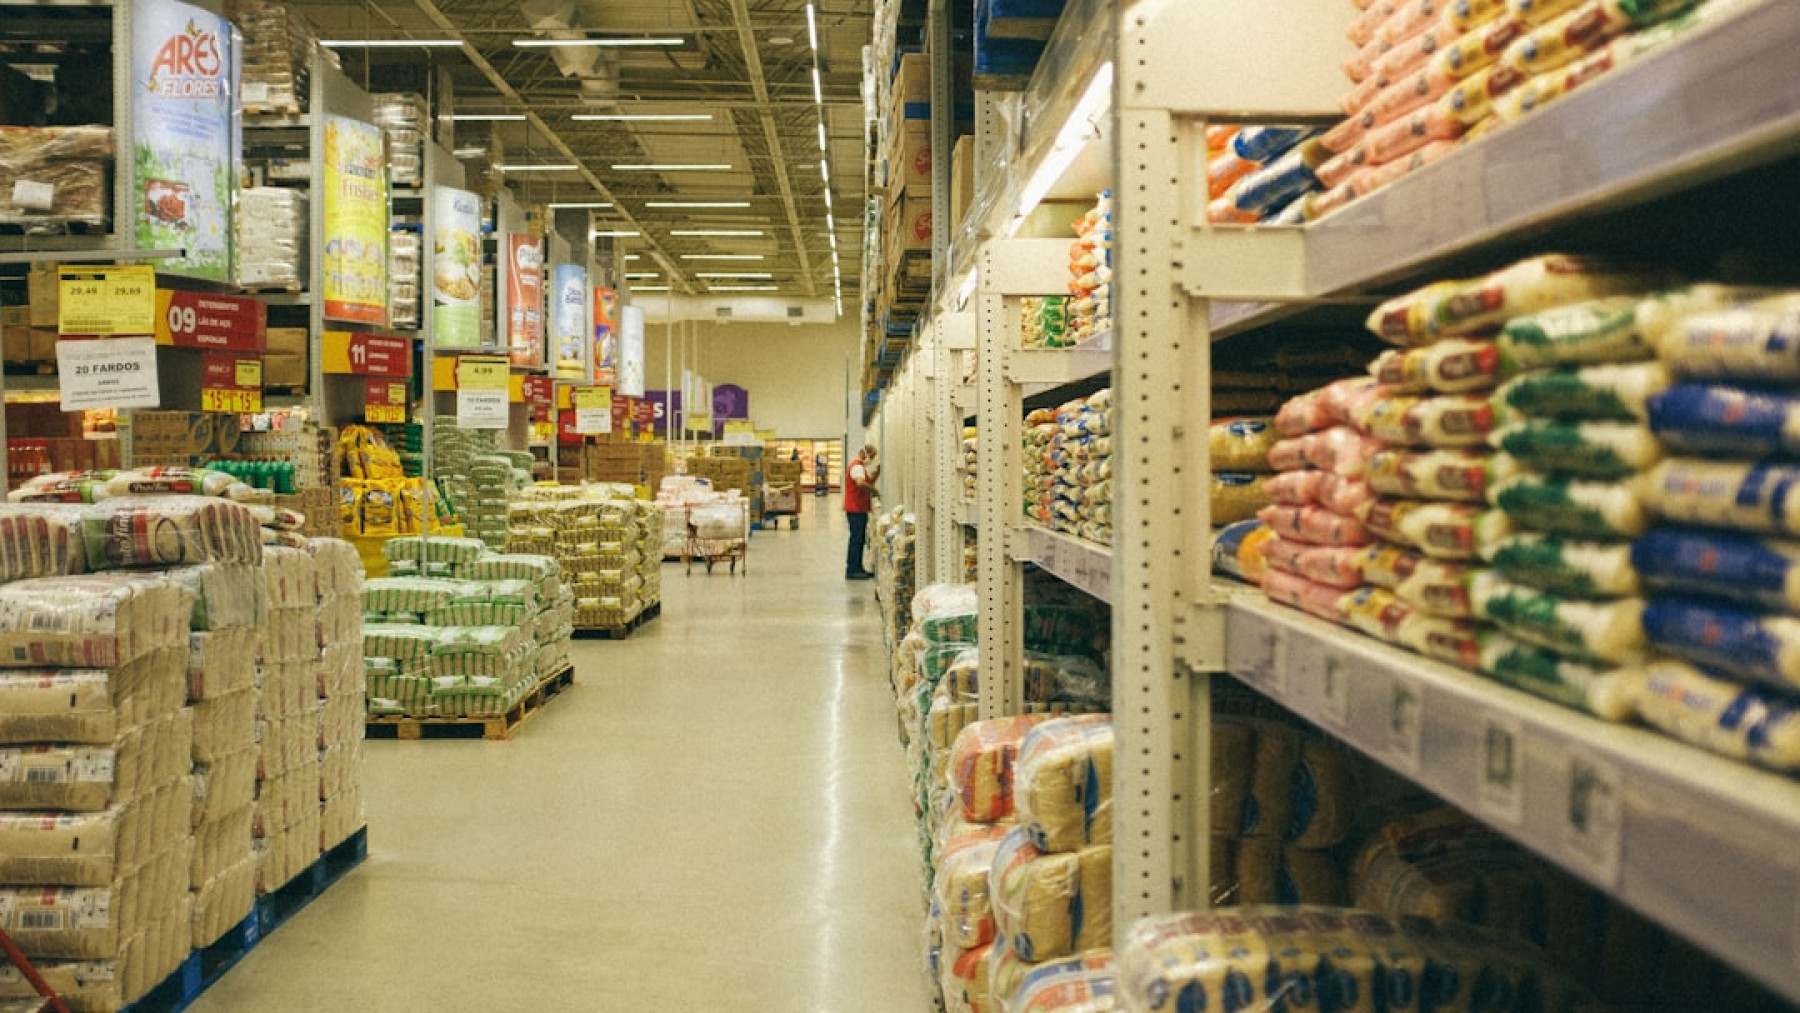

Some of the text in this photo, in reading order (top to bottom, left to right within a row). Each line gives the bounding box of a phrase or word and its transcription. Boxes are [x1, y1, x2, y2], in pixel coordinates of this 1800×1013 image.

[150, 32, 222, 78] ARES
[158, 80, 218, 97] FLORES
[169, 305, 196, 334] 09
[351, 343, 366, 365] 11
[75, 361, 141, 374] 20 FARDOS
